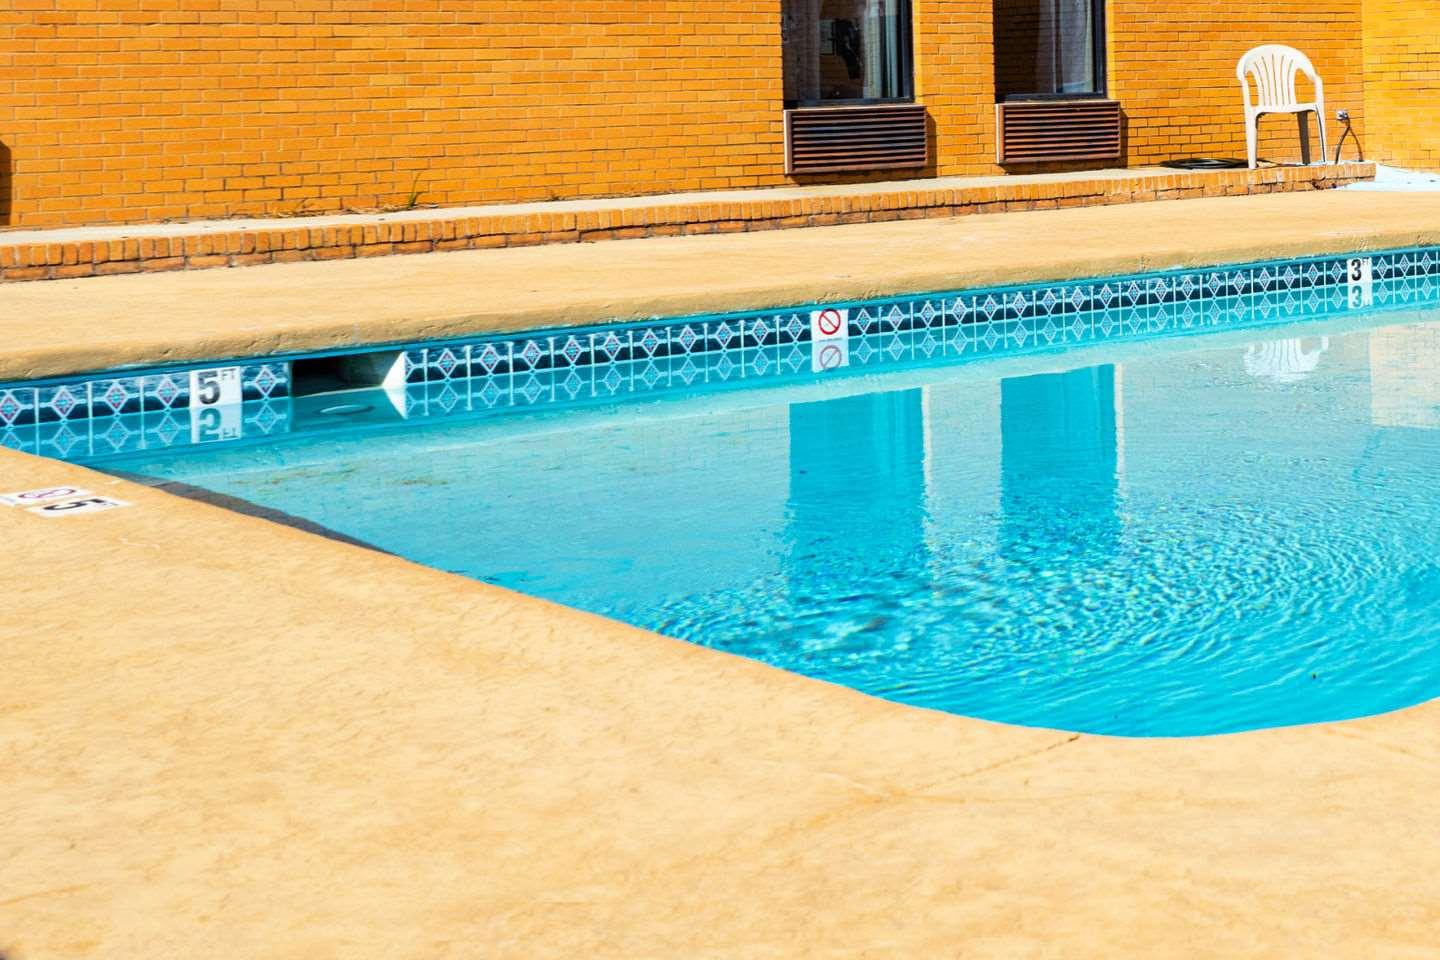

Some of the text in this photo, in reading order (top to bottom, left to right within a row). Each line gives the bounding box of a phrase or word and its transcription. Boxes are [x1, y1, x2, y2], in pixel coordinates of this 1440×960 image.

[1351, 259, 1362, 281] 3
[198, 368, 237, 405] 5 FT
